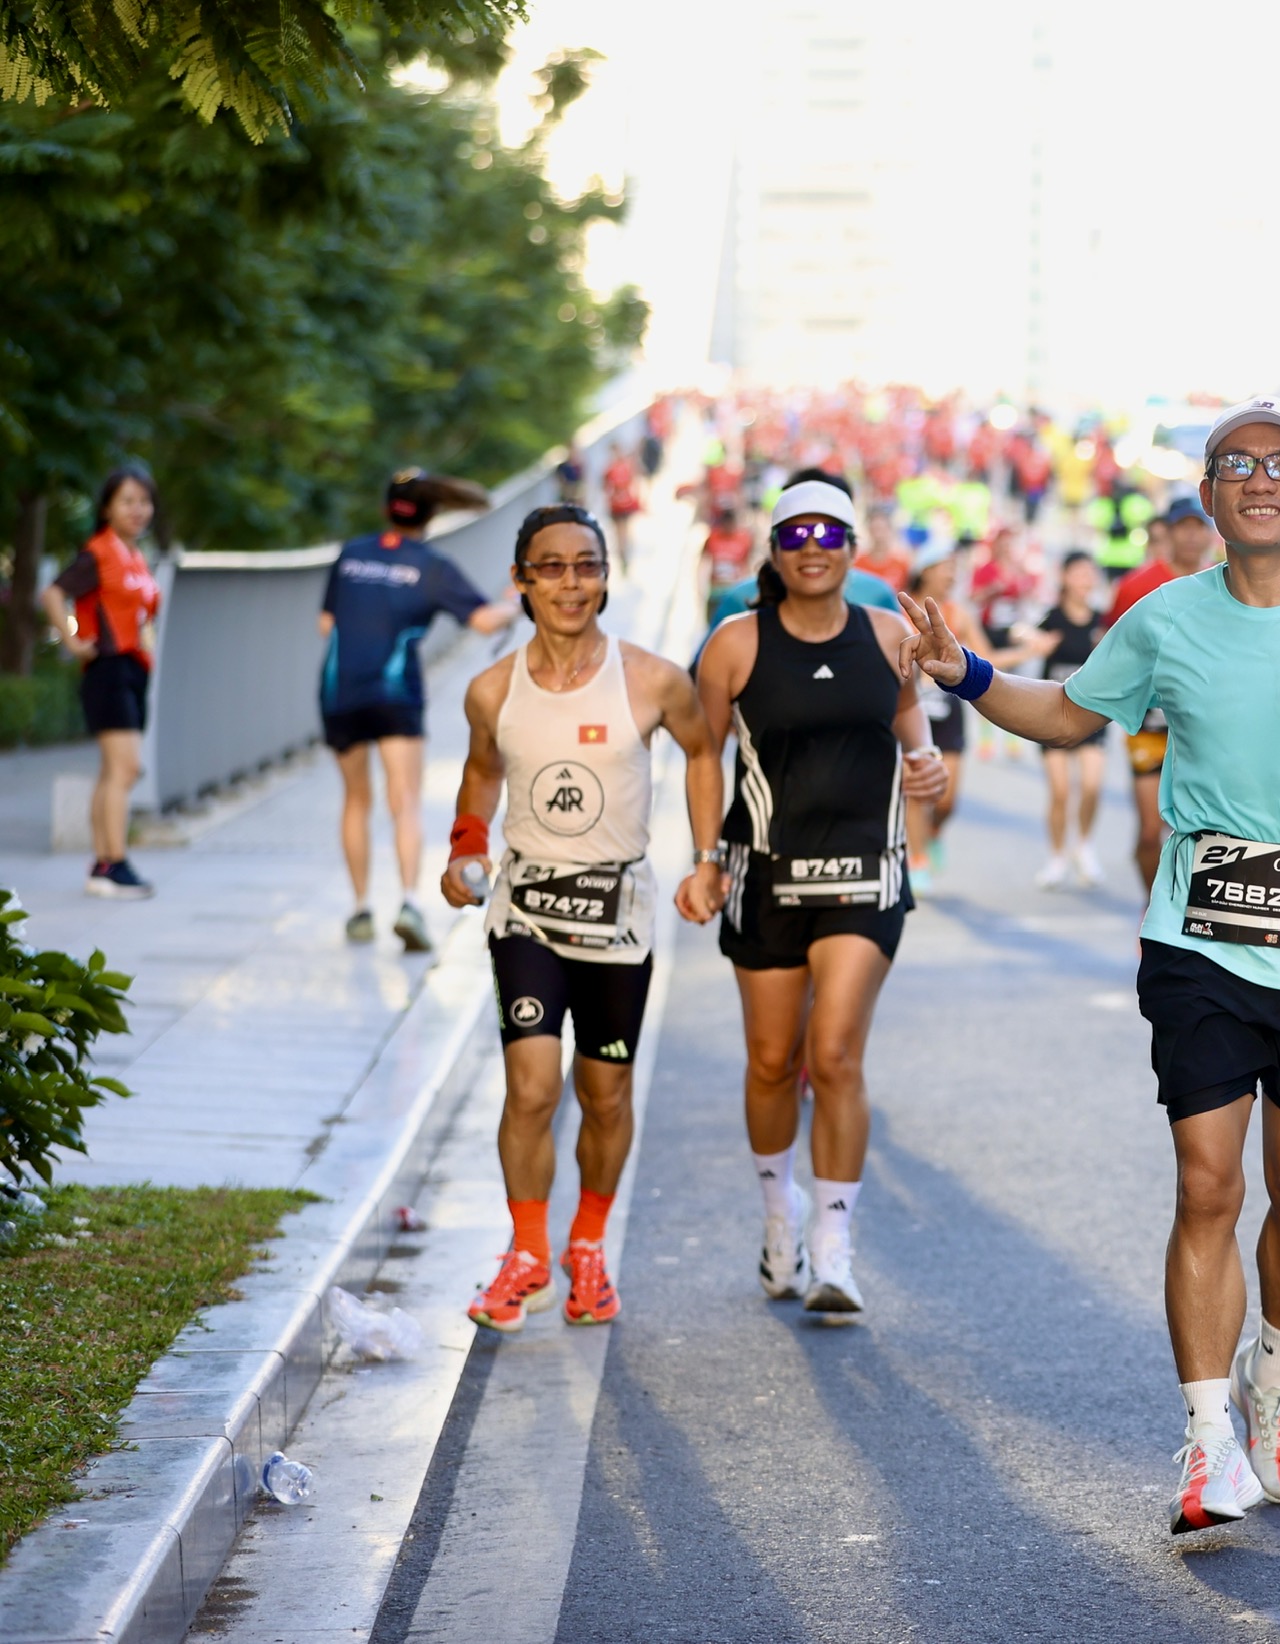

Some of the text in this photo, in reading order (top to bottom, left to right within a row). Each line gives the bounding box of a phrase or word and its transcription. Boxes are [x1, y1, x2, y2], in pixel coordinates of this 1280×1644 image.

[545, 787, 584, 813] AR
[1201, 845, 1249, 864] 21
[576, 875, 617, 892] Ocany
[524, 890, 604, 917] 87472
